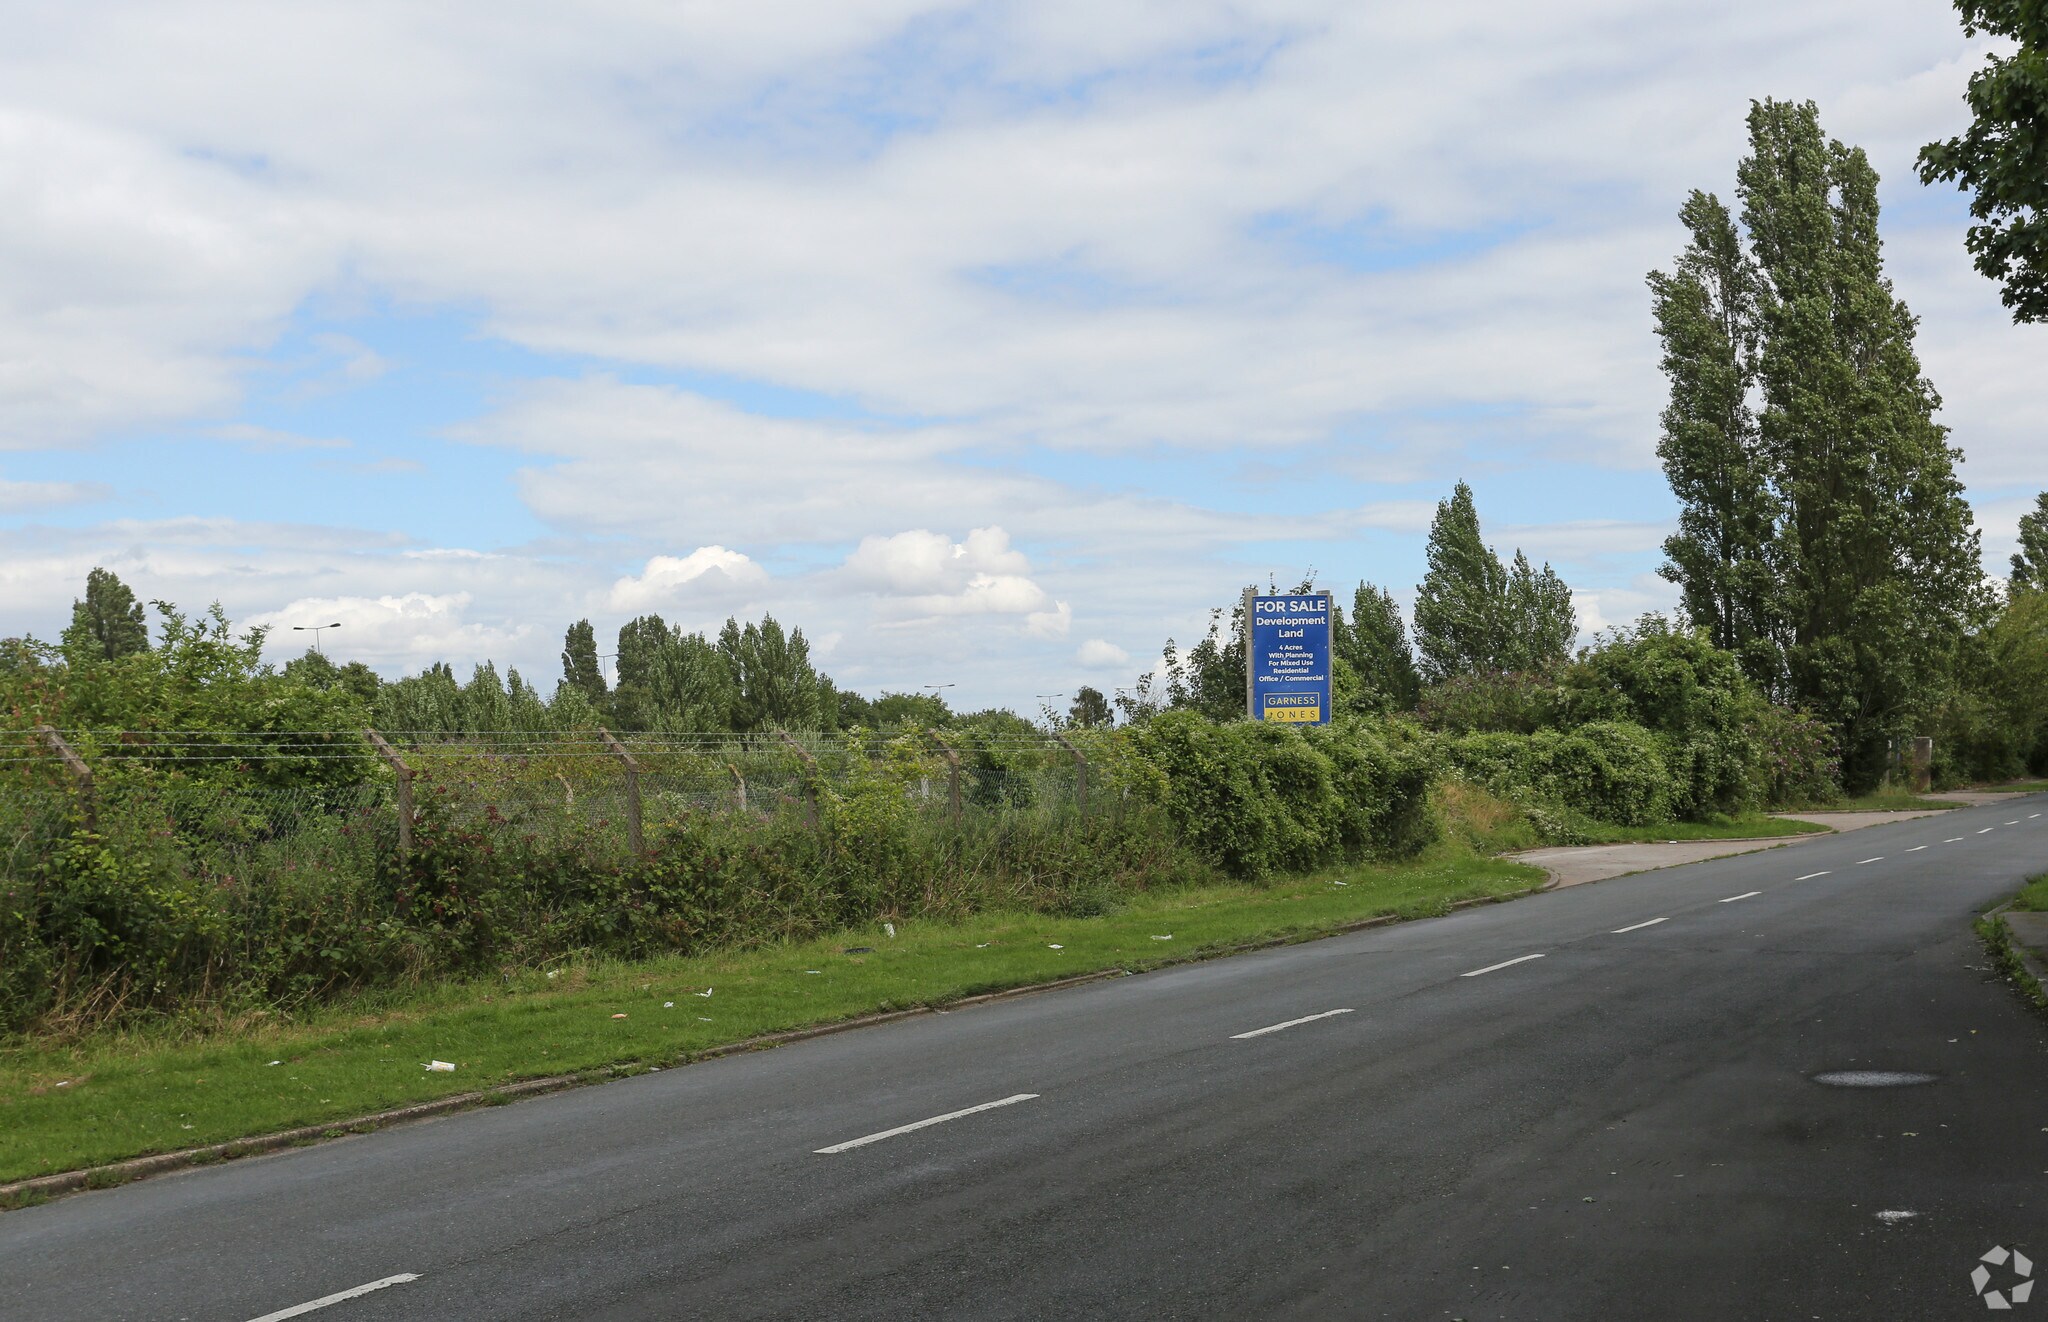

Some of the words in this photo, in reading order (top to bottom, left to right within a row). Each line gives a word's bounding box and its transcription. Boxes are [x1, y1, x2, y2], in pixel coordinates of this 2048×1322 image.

[1255, 601, 1286, 613] FOR
[1289, 600, 1326, 612] SALE
[1256, 616, 1326, 627] Development
[1278, 628, 1304, 638] Land
[1285, 651, 1314, 659] Planning
[1268, 696, 1316, 705] GARNESS
